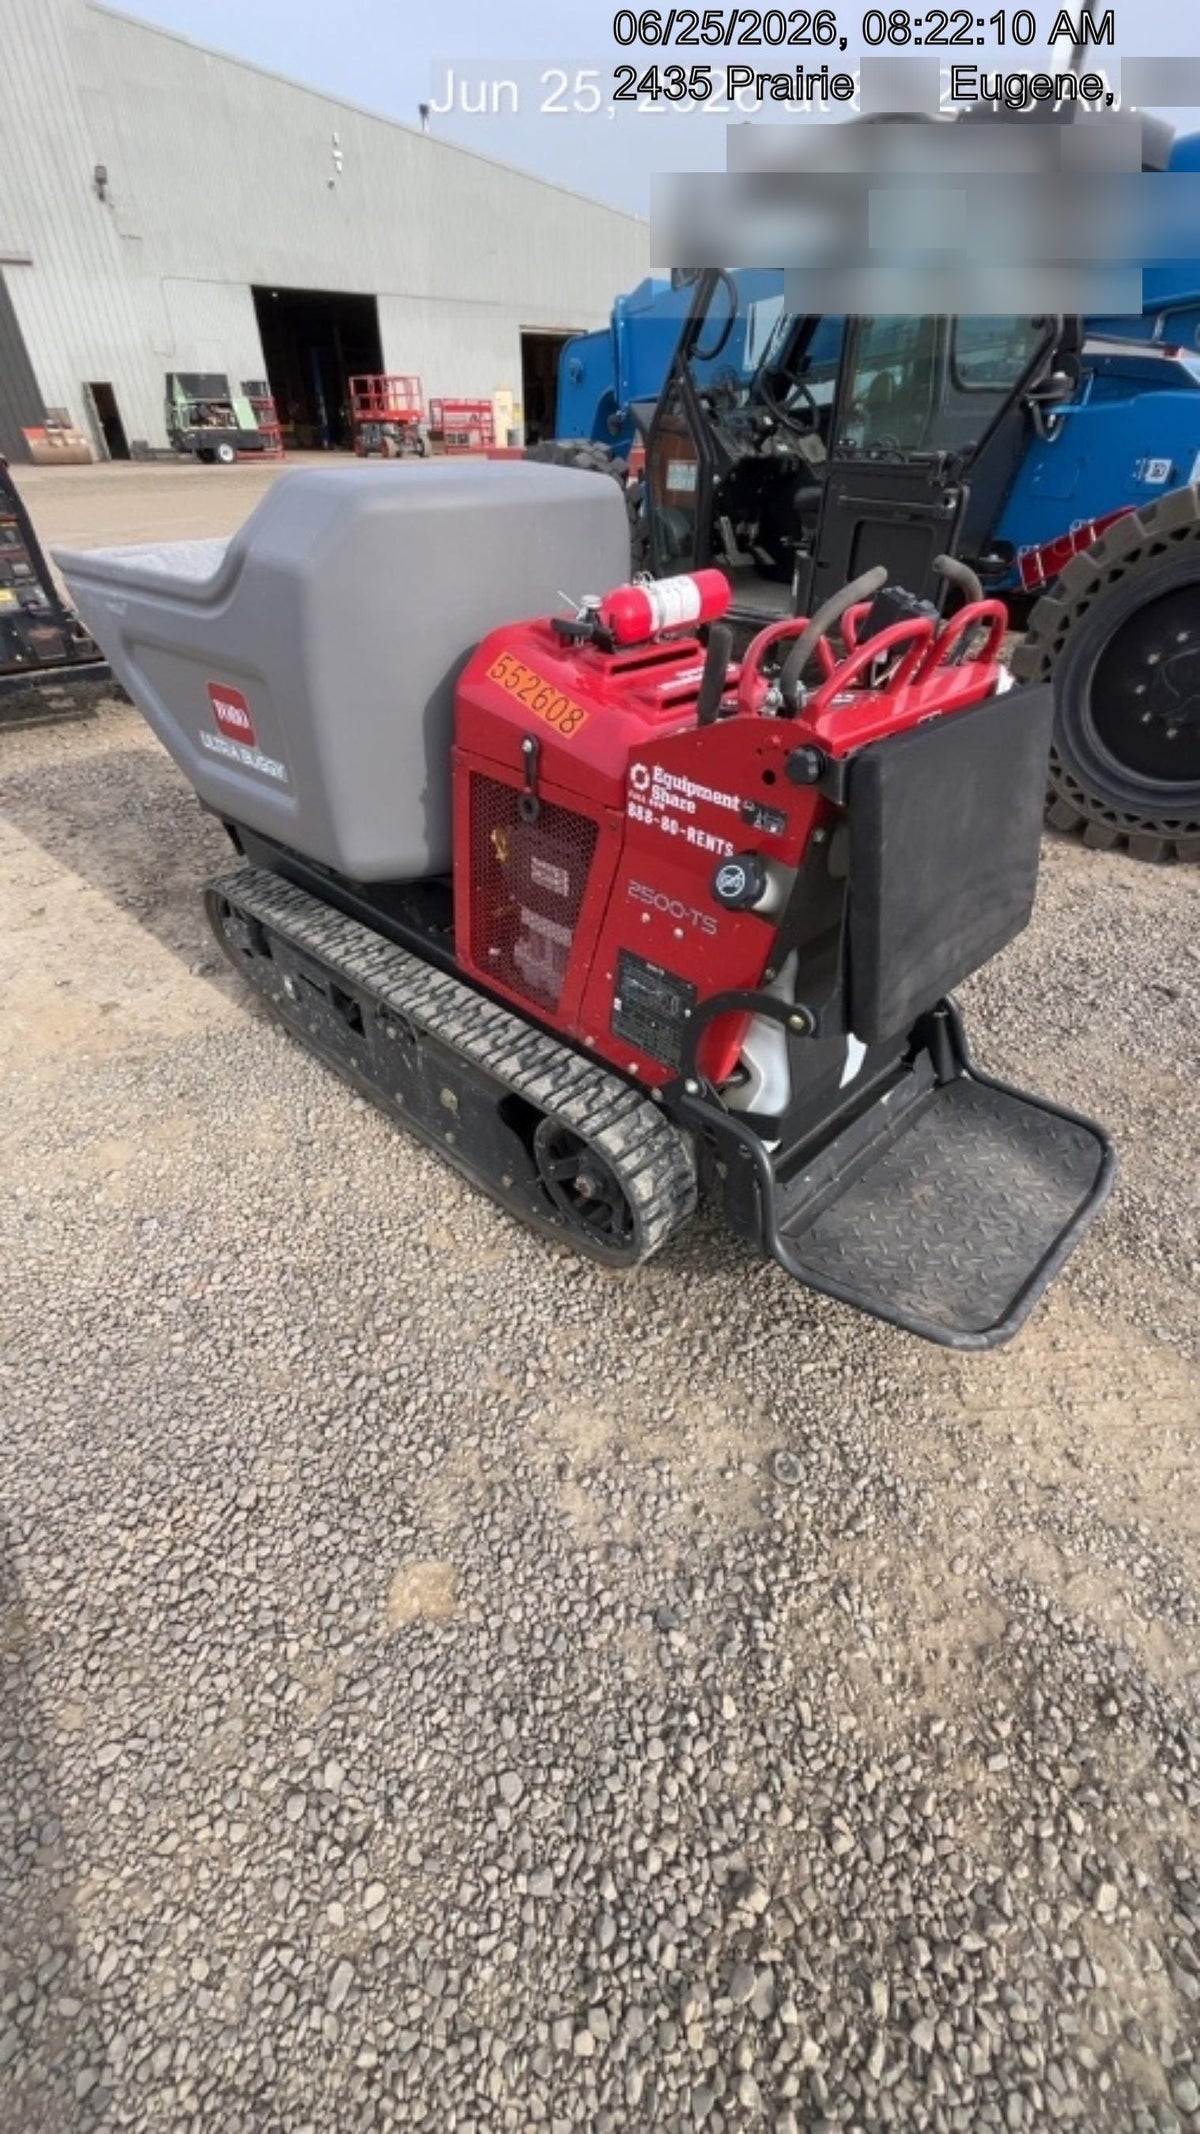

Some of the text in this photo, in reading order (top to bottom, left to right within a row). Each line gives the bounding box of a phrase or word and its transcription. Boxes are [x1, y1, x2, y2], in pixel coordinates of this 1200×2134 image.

[490, 655, 585, 734] 552608
[199, 729, 241, 761] ULTRA
[651, 764, 742, 813] Equipment
[651, 784, 697, 815] Share
[627, 801, 735, 858] 888-80-RENTS
[626, 879, 719, 936] 2500-TS
